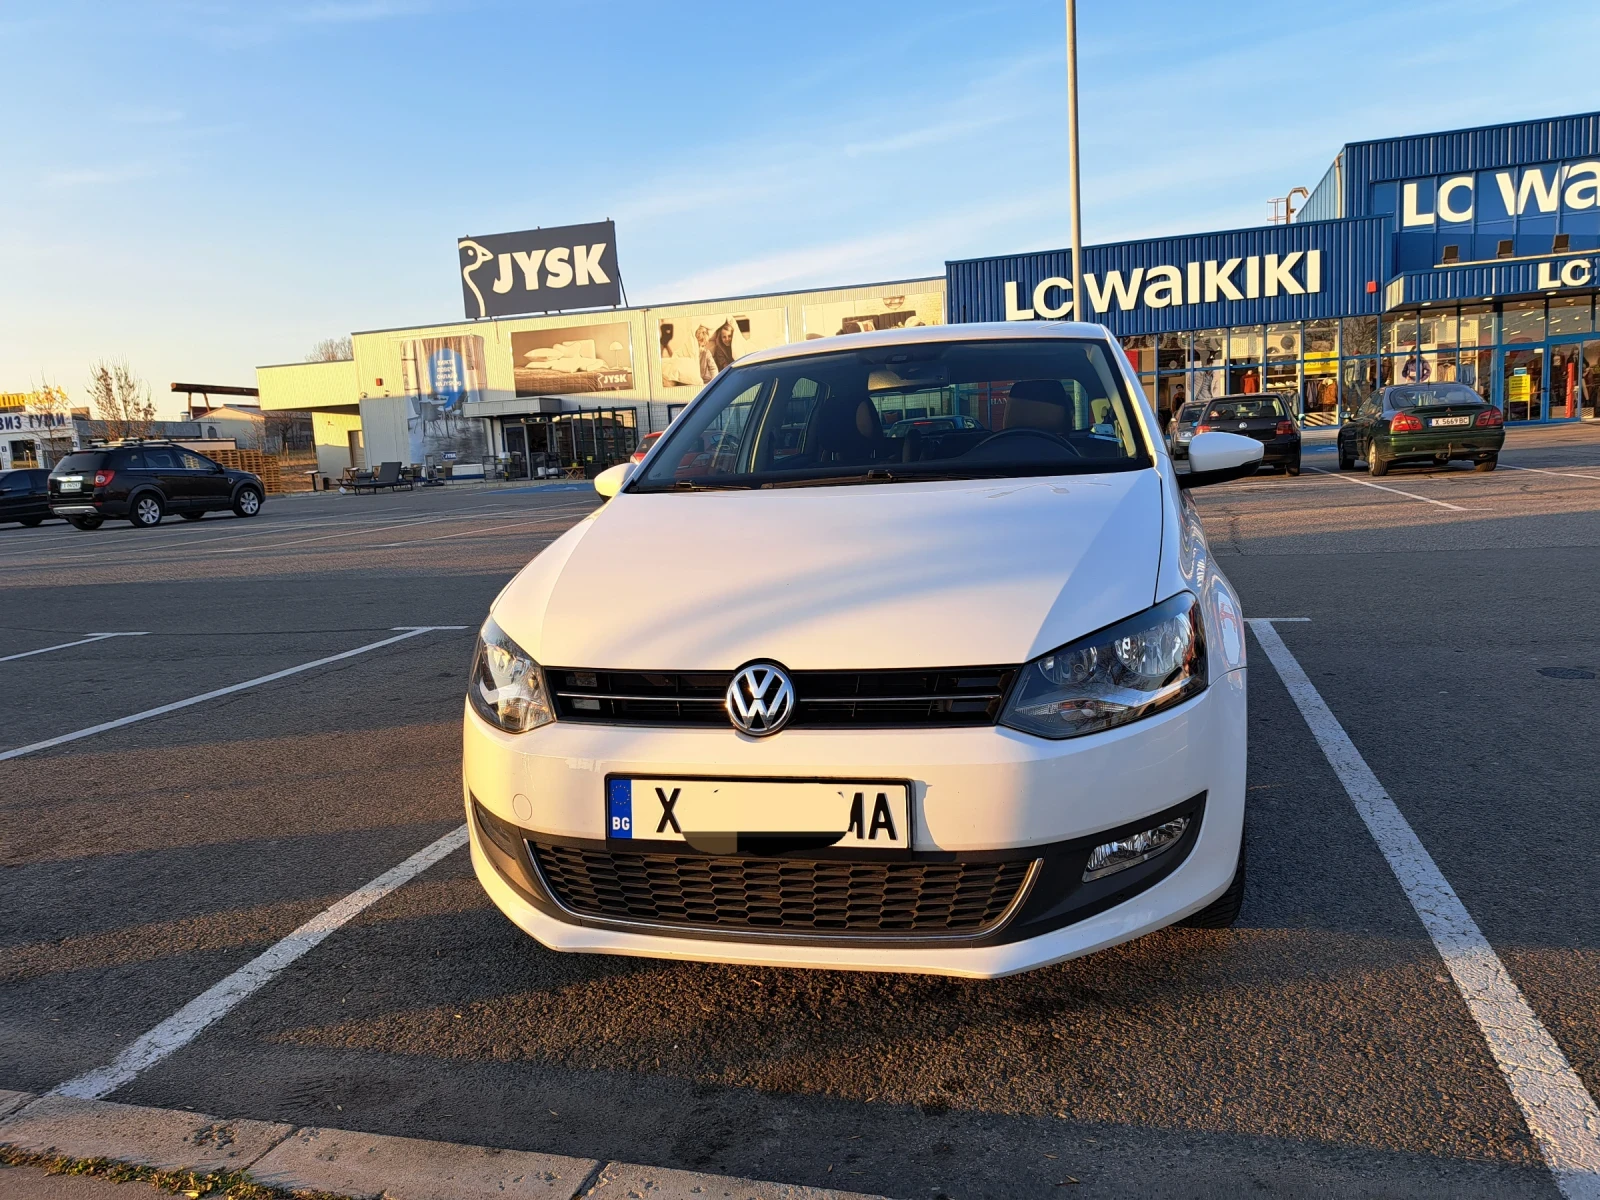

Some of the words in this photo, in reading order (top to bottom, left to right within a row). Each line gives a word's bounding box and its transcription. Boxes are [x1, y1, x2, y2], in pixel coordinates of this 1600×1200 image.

[1403, 176, 1473, 227] LC
[492, 243, 611, 294] JYSK
[1537, 259, 1591, 290] LC
[1004, 276, 1074, 321] LC
[603, 373, 628, 384] JYSK
[612, 816, 630, 831] BG
[655, 787, 682, 834] X
